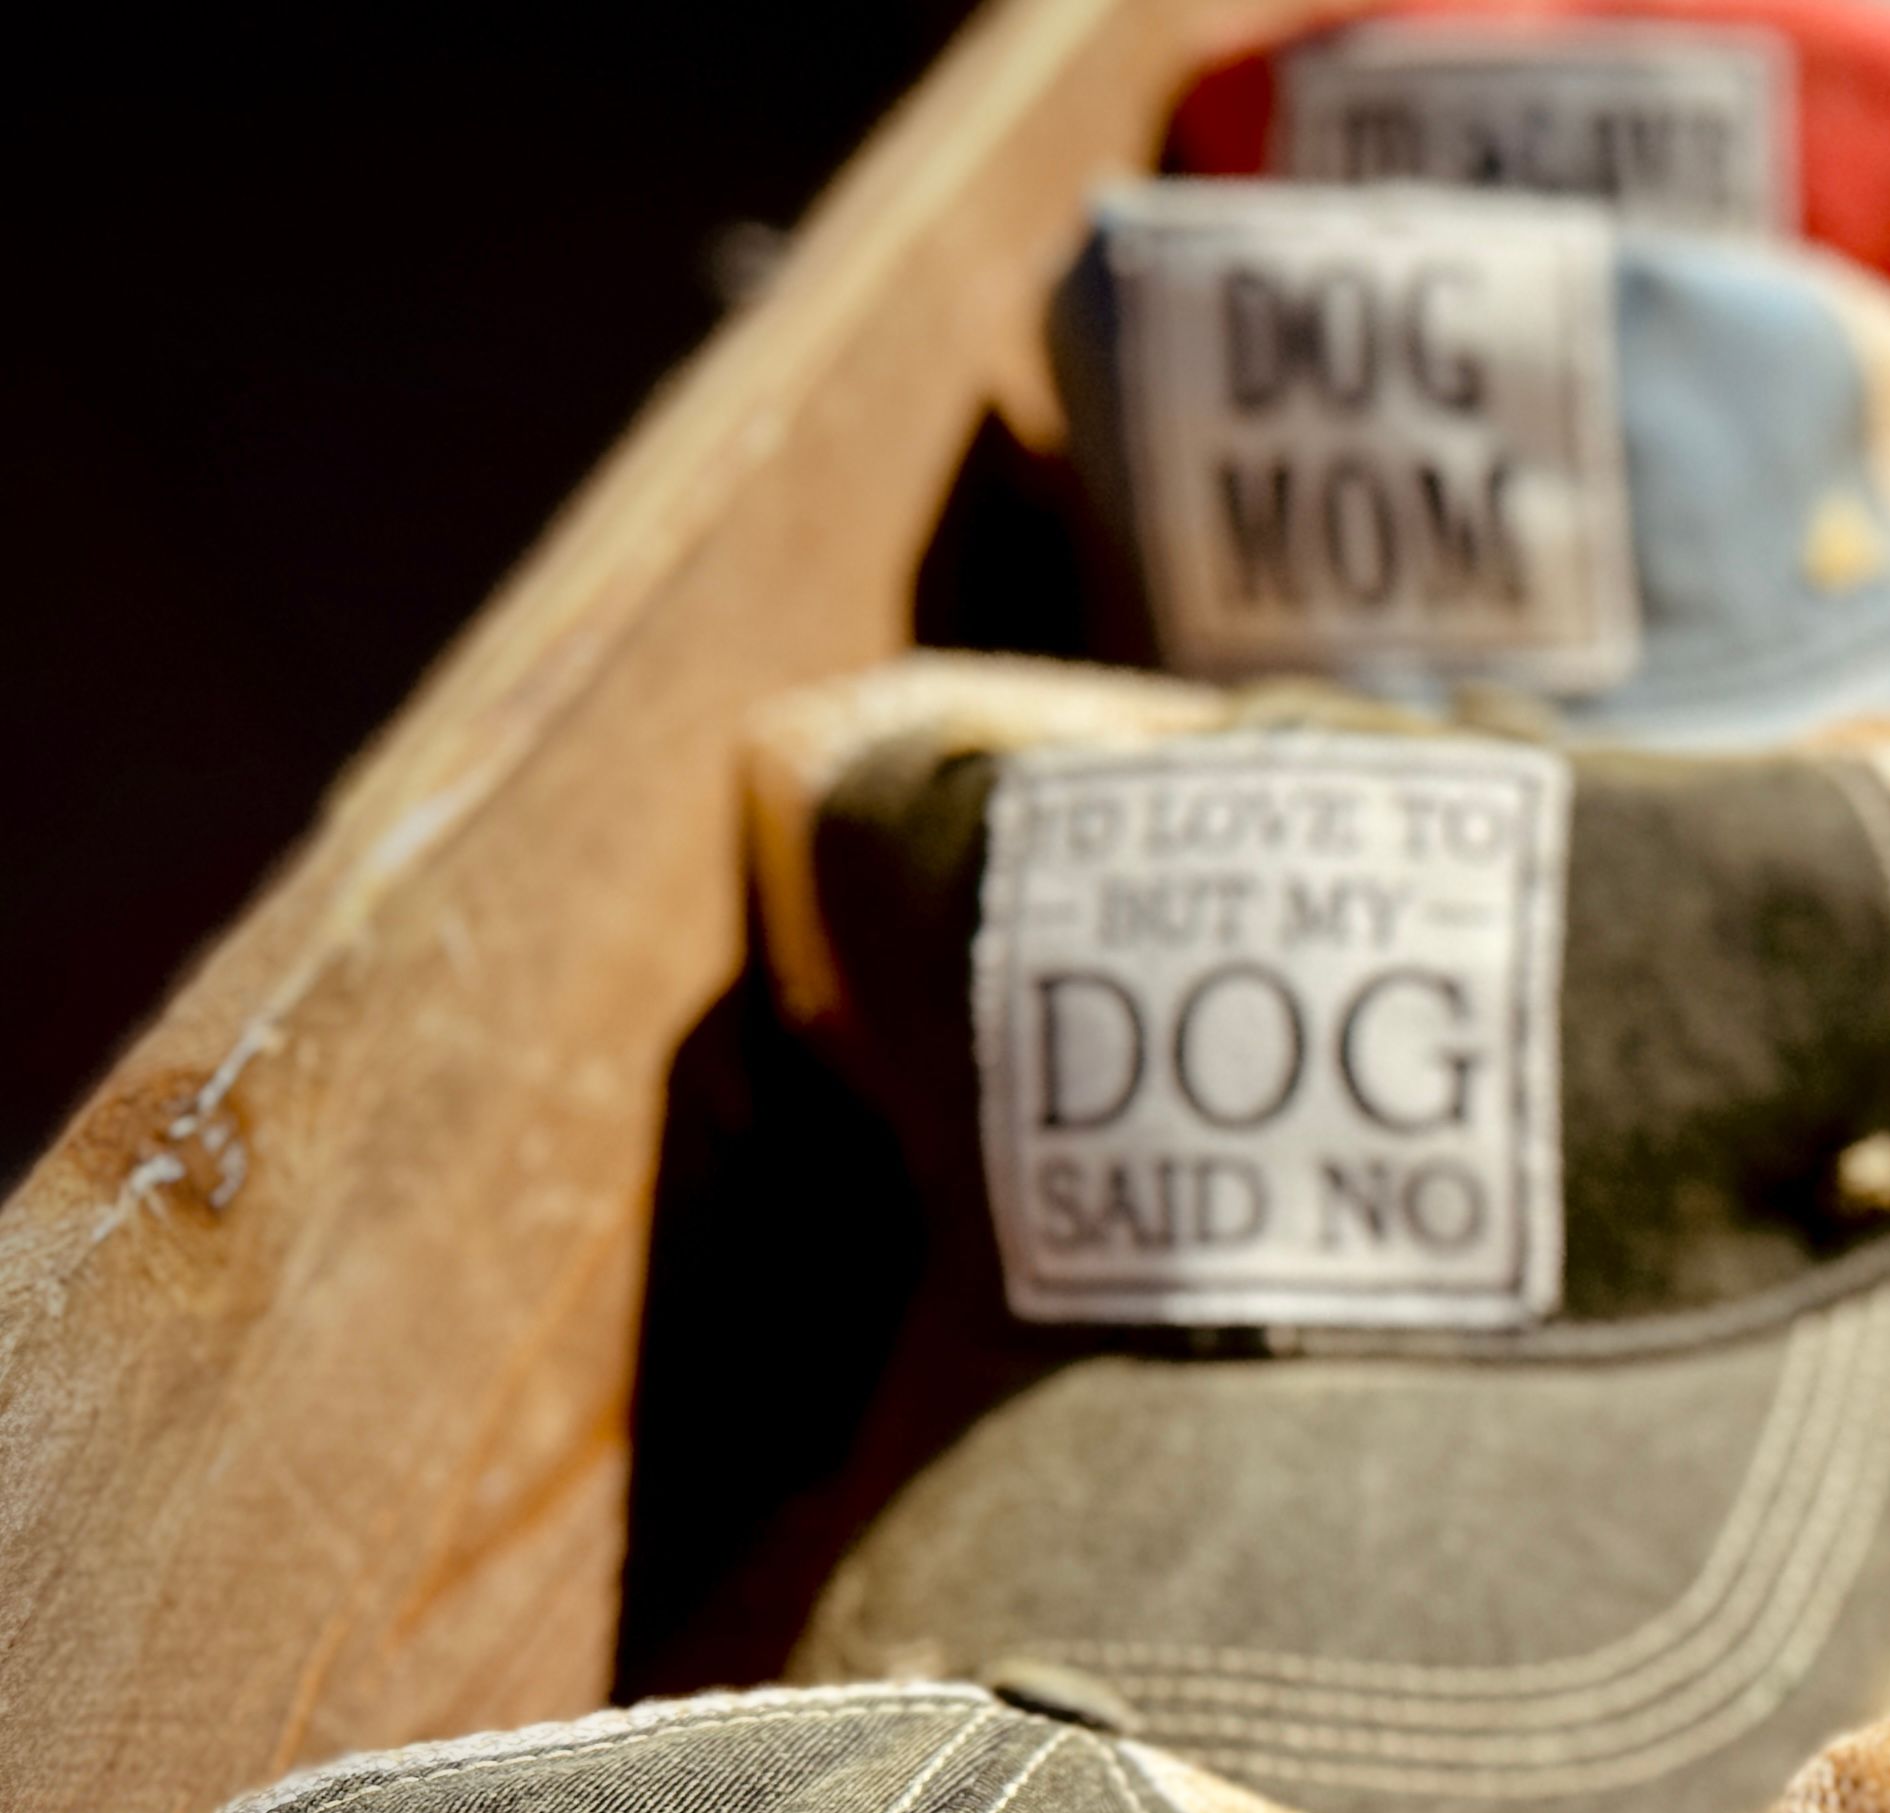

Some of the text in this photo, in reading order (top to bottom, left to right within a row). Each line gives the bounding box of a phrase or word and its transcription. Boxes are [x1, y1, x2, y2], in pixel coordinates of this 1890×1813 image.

[1225, 262, 1487, 411] DOG
[1220, 459, 1522, 605] MOM
[1143, 787, 1360, 860] LOVE
[1397, 792, 1510, 864] TO
[1278, 872, 1411, 950] MY
[1036, 960, 1481, 1134] DOG
[1040, 1155, 1488, 1253] SAID NO
